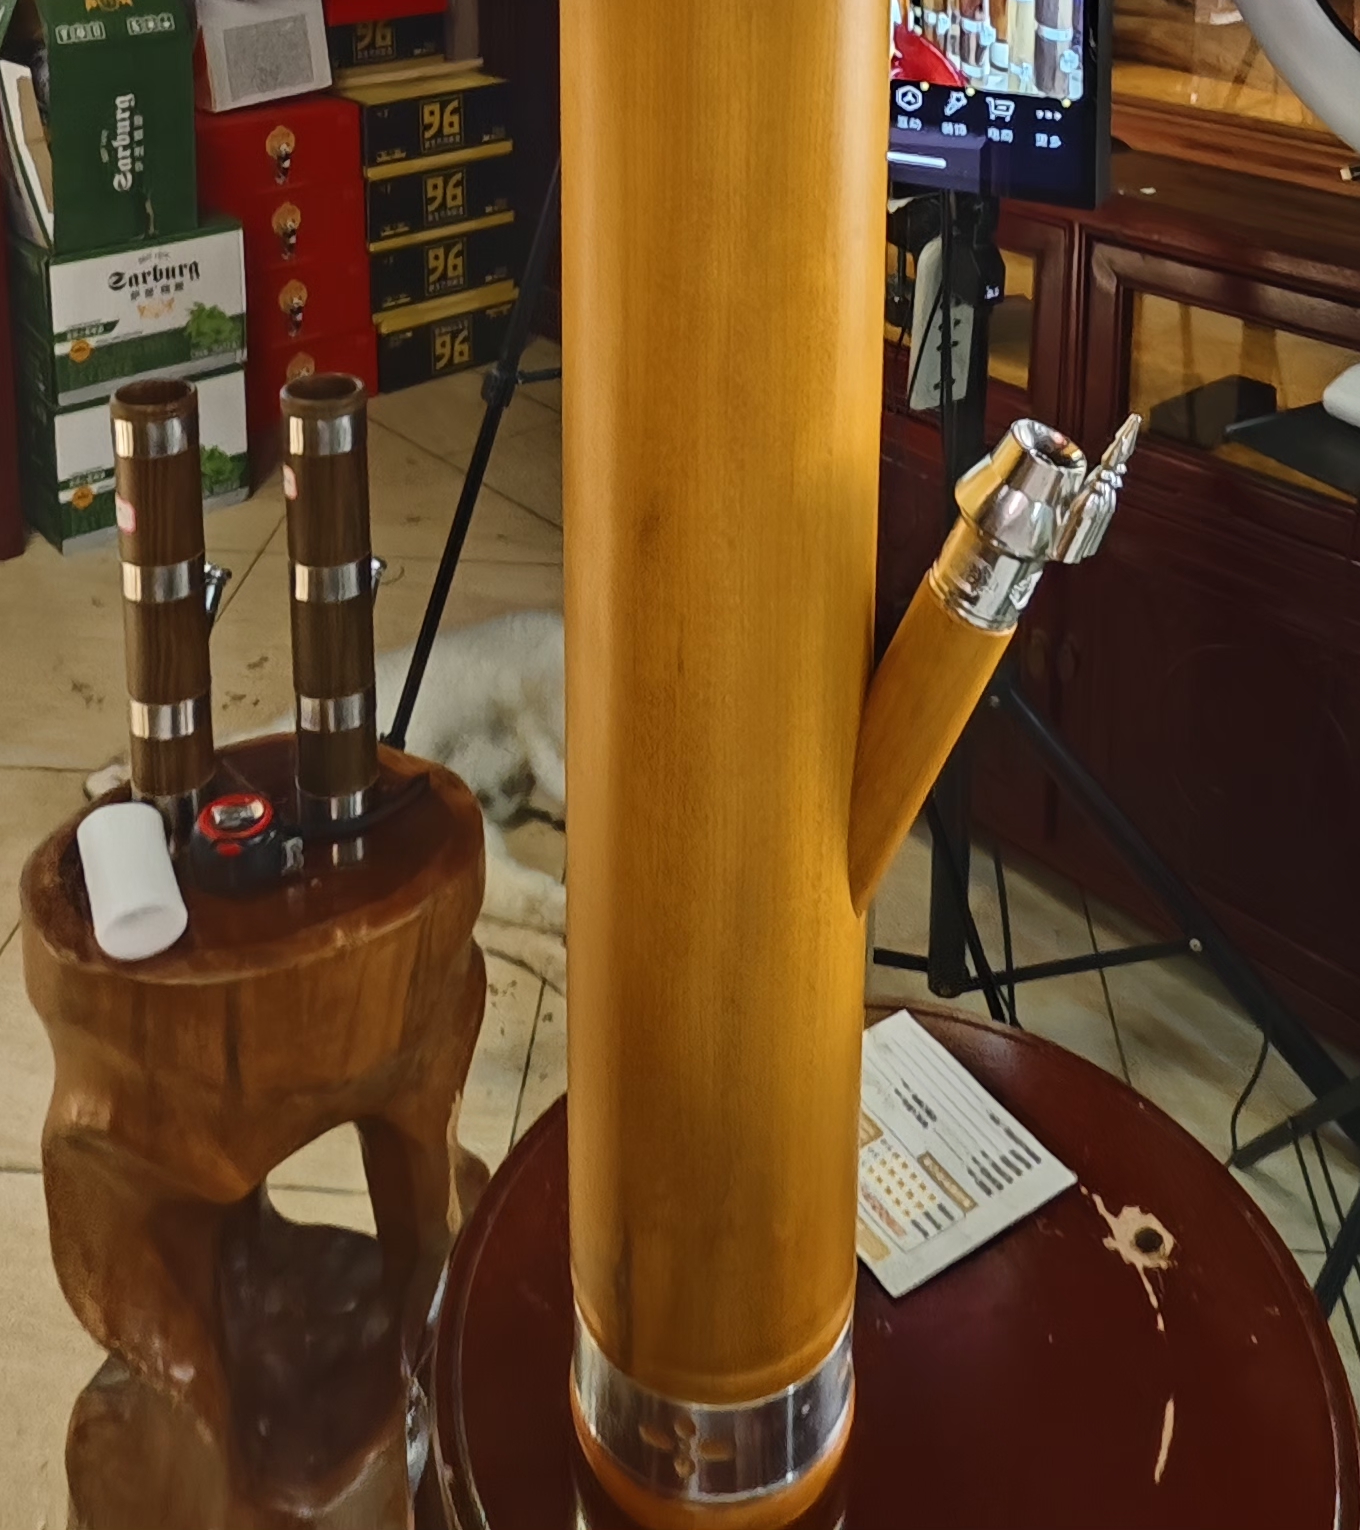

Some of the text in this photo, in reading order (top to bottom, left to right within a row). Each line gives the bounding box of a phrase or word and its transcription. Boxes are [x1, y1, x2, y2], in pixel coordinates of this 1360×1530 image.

[423, 99, 461, 139] 96
[112, 92, 136, 192] Sarburg
[426, 172, 464, 212] 96
[107, 259, 201, 292] Sarburg
[427, 242, 464, 283] 96
[434, 329, 471, 370] 96
